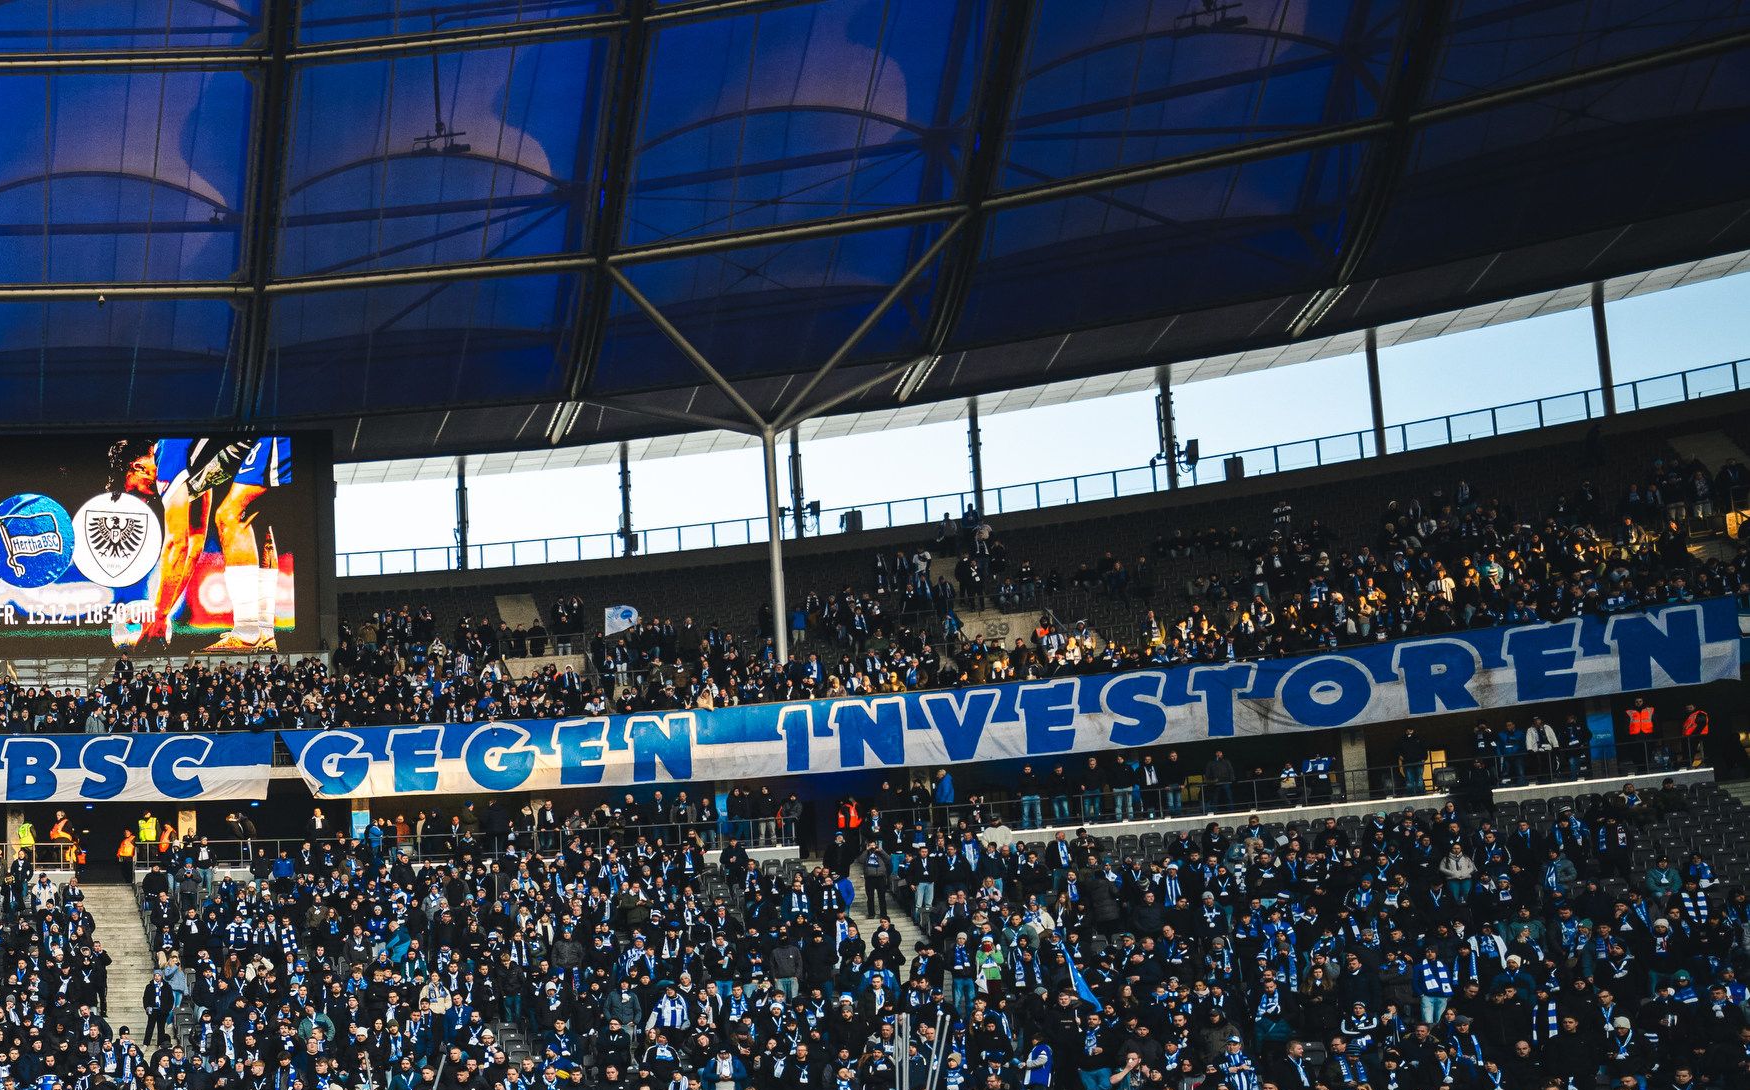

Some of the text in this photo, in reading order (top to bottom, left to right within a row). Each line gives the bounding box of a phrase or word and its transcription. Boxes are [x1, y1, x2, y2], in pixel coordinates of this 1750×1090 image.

[26, 604, 72, 625] 13.12.
[84, 603, 126, 625] 18:30
[301, 604, 1707, 796] GEGEN INVESTOREN
[0, 735, 213, 802] BSC
